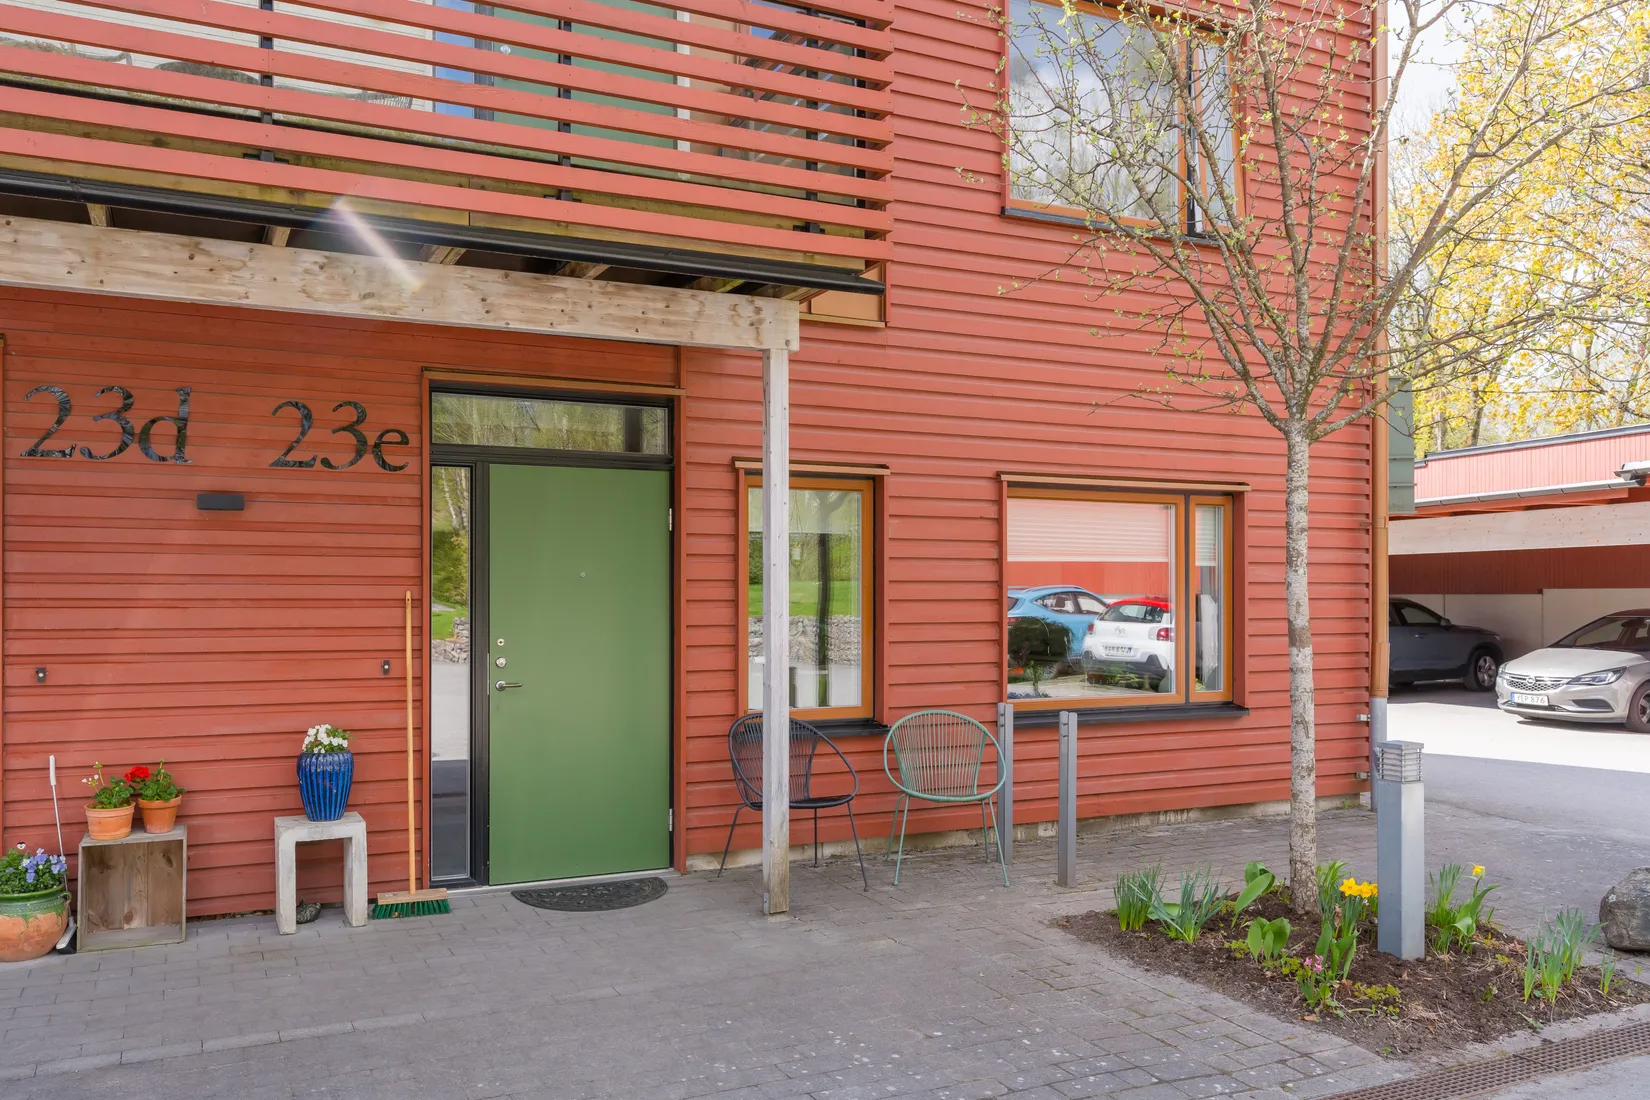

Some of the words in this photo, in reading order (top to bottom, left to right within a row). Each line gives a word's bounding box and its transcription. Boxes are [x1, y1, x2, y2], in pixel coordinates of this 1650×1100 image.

[19, 385, 193, 465] 23d
[268, 400, 410, 472] 23e
[1530, 696, 1545, 704] 876
